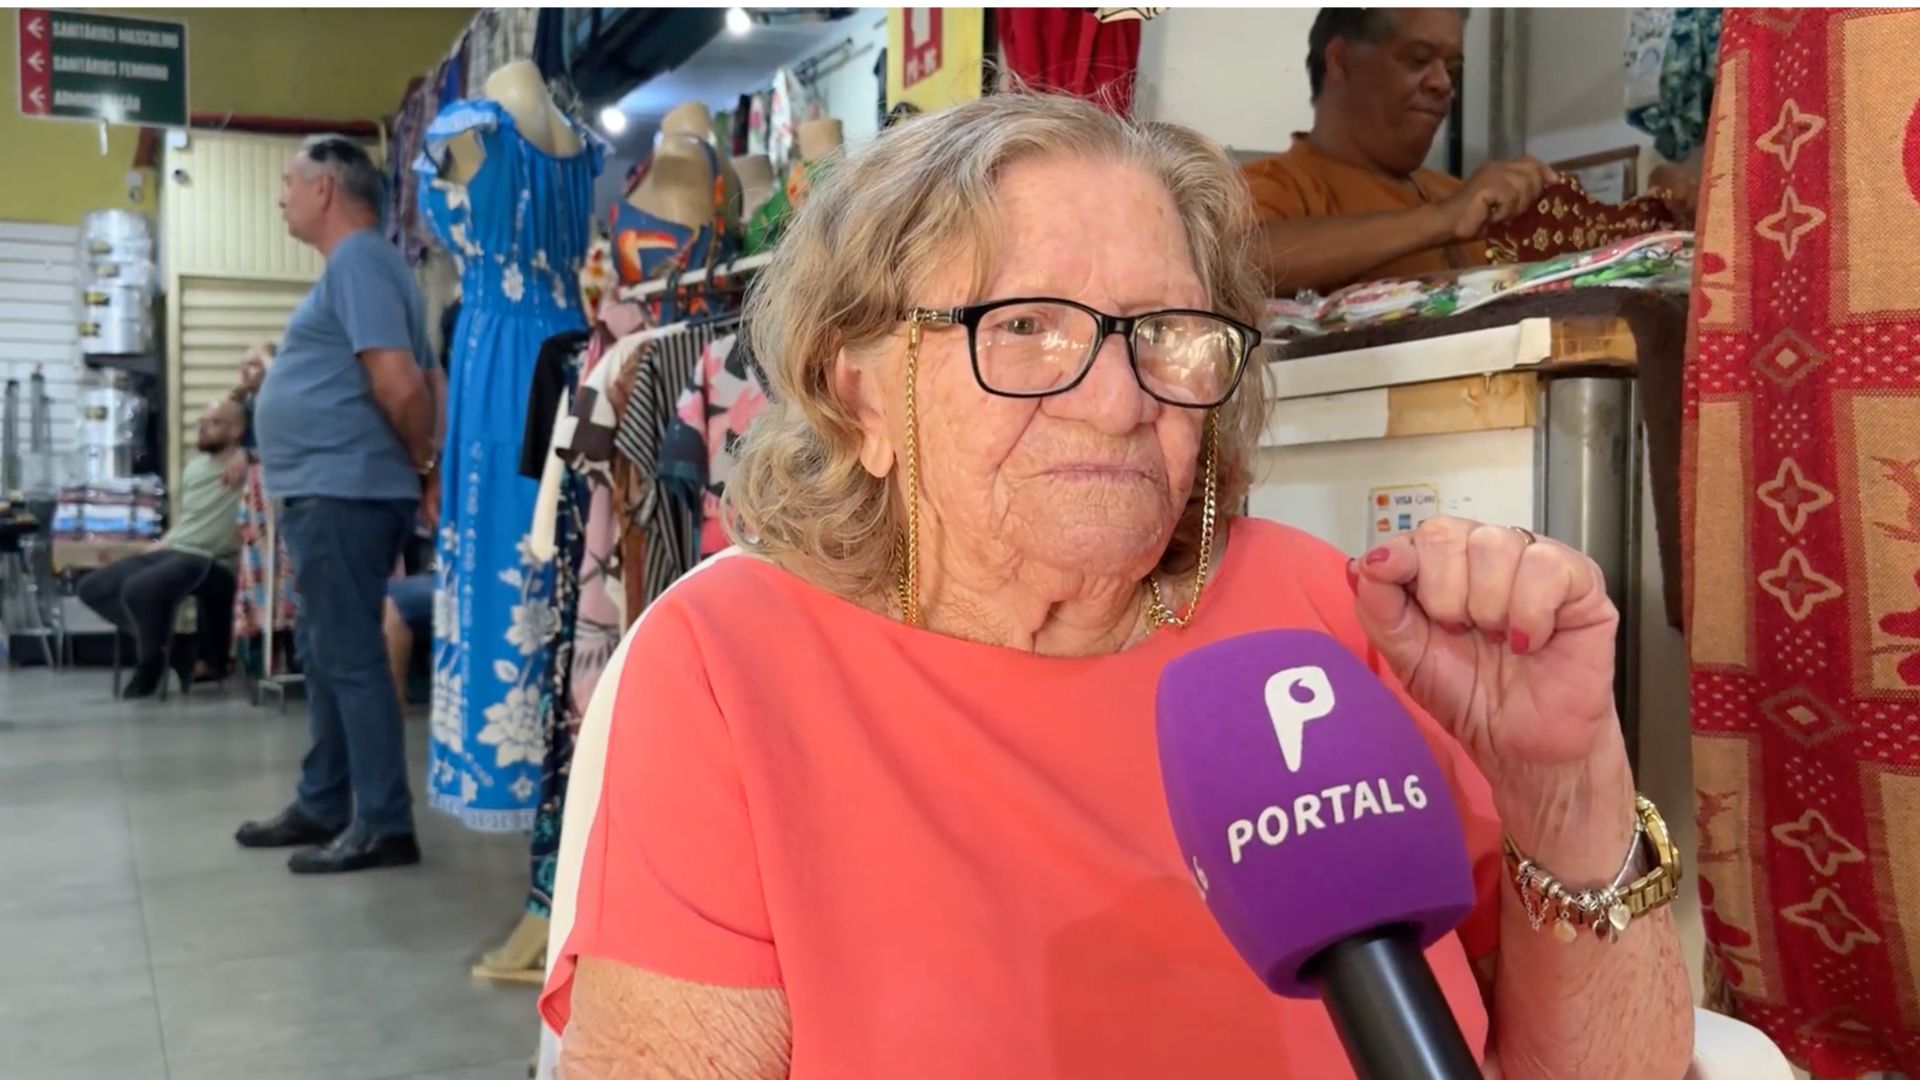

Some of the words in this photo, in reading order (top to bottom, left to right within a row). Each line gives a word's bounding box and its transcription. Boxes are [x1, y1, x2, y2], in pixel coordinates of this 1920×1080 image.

[53, 20, 116, 43] SANITÁRIOS
[118, 28, 180, 50] MASCULINO
[53, 54, 117, 76] SANITÁRIOS
[119, 61, 169, 81] FEMININO
[1394, 495, 1413, 506] VISA
[1227, 774, 1428, 864] PORTAL6
